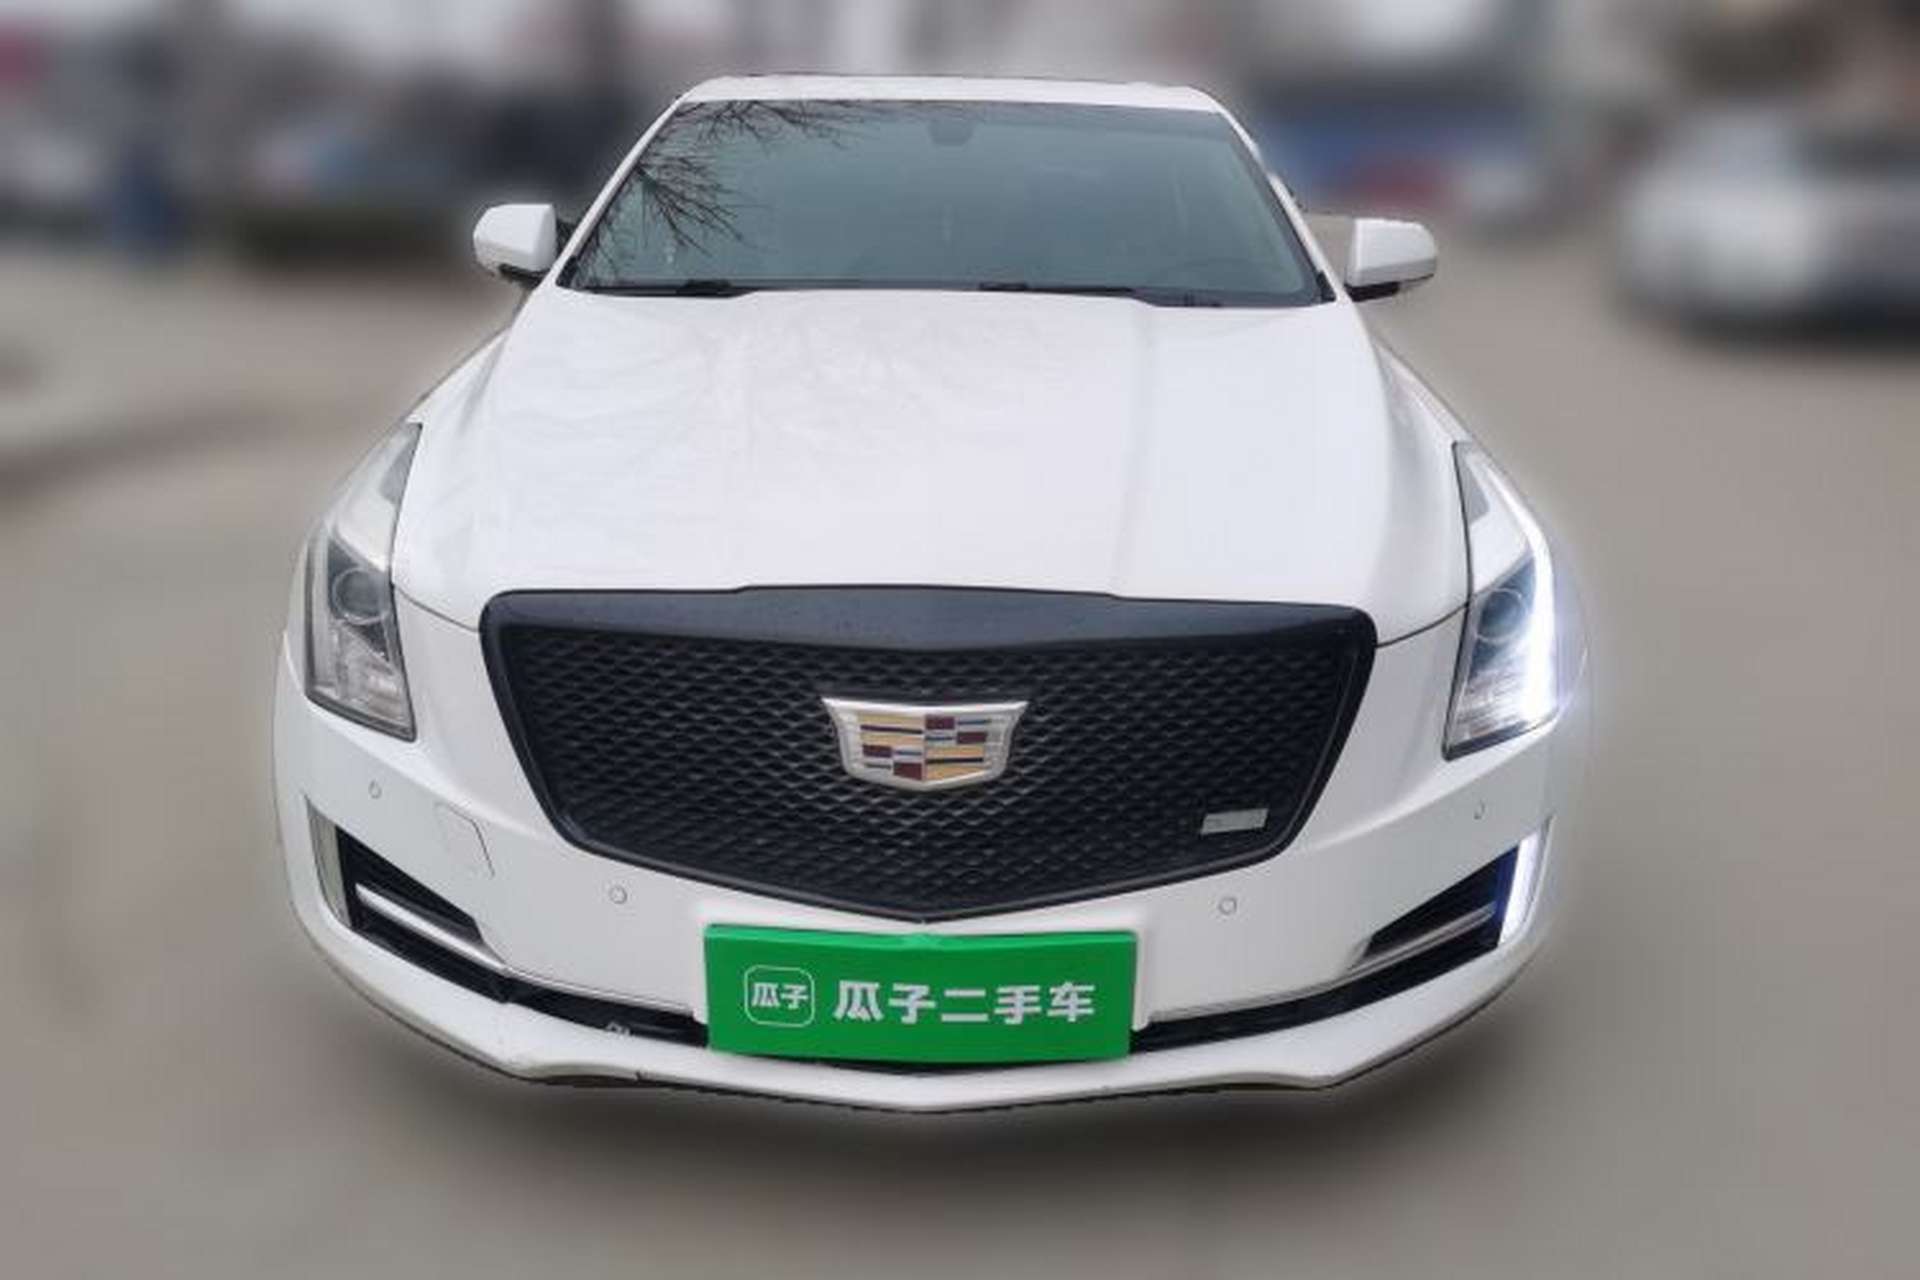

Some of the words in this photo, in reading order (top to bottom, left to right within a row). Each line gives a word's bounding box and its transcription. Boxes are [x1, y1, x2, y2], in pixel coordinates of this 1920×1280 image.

[751, 982, 809, 1010] 瓜子
[833, 980, 1096, 1025] 瓜子二手车
